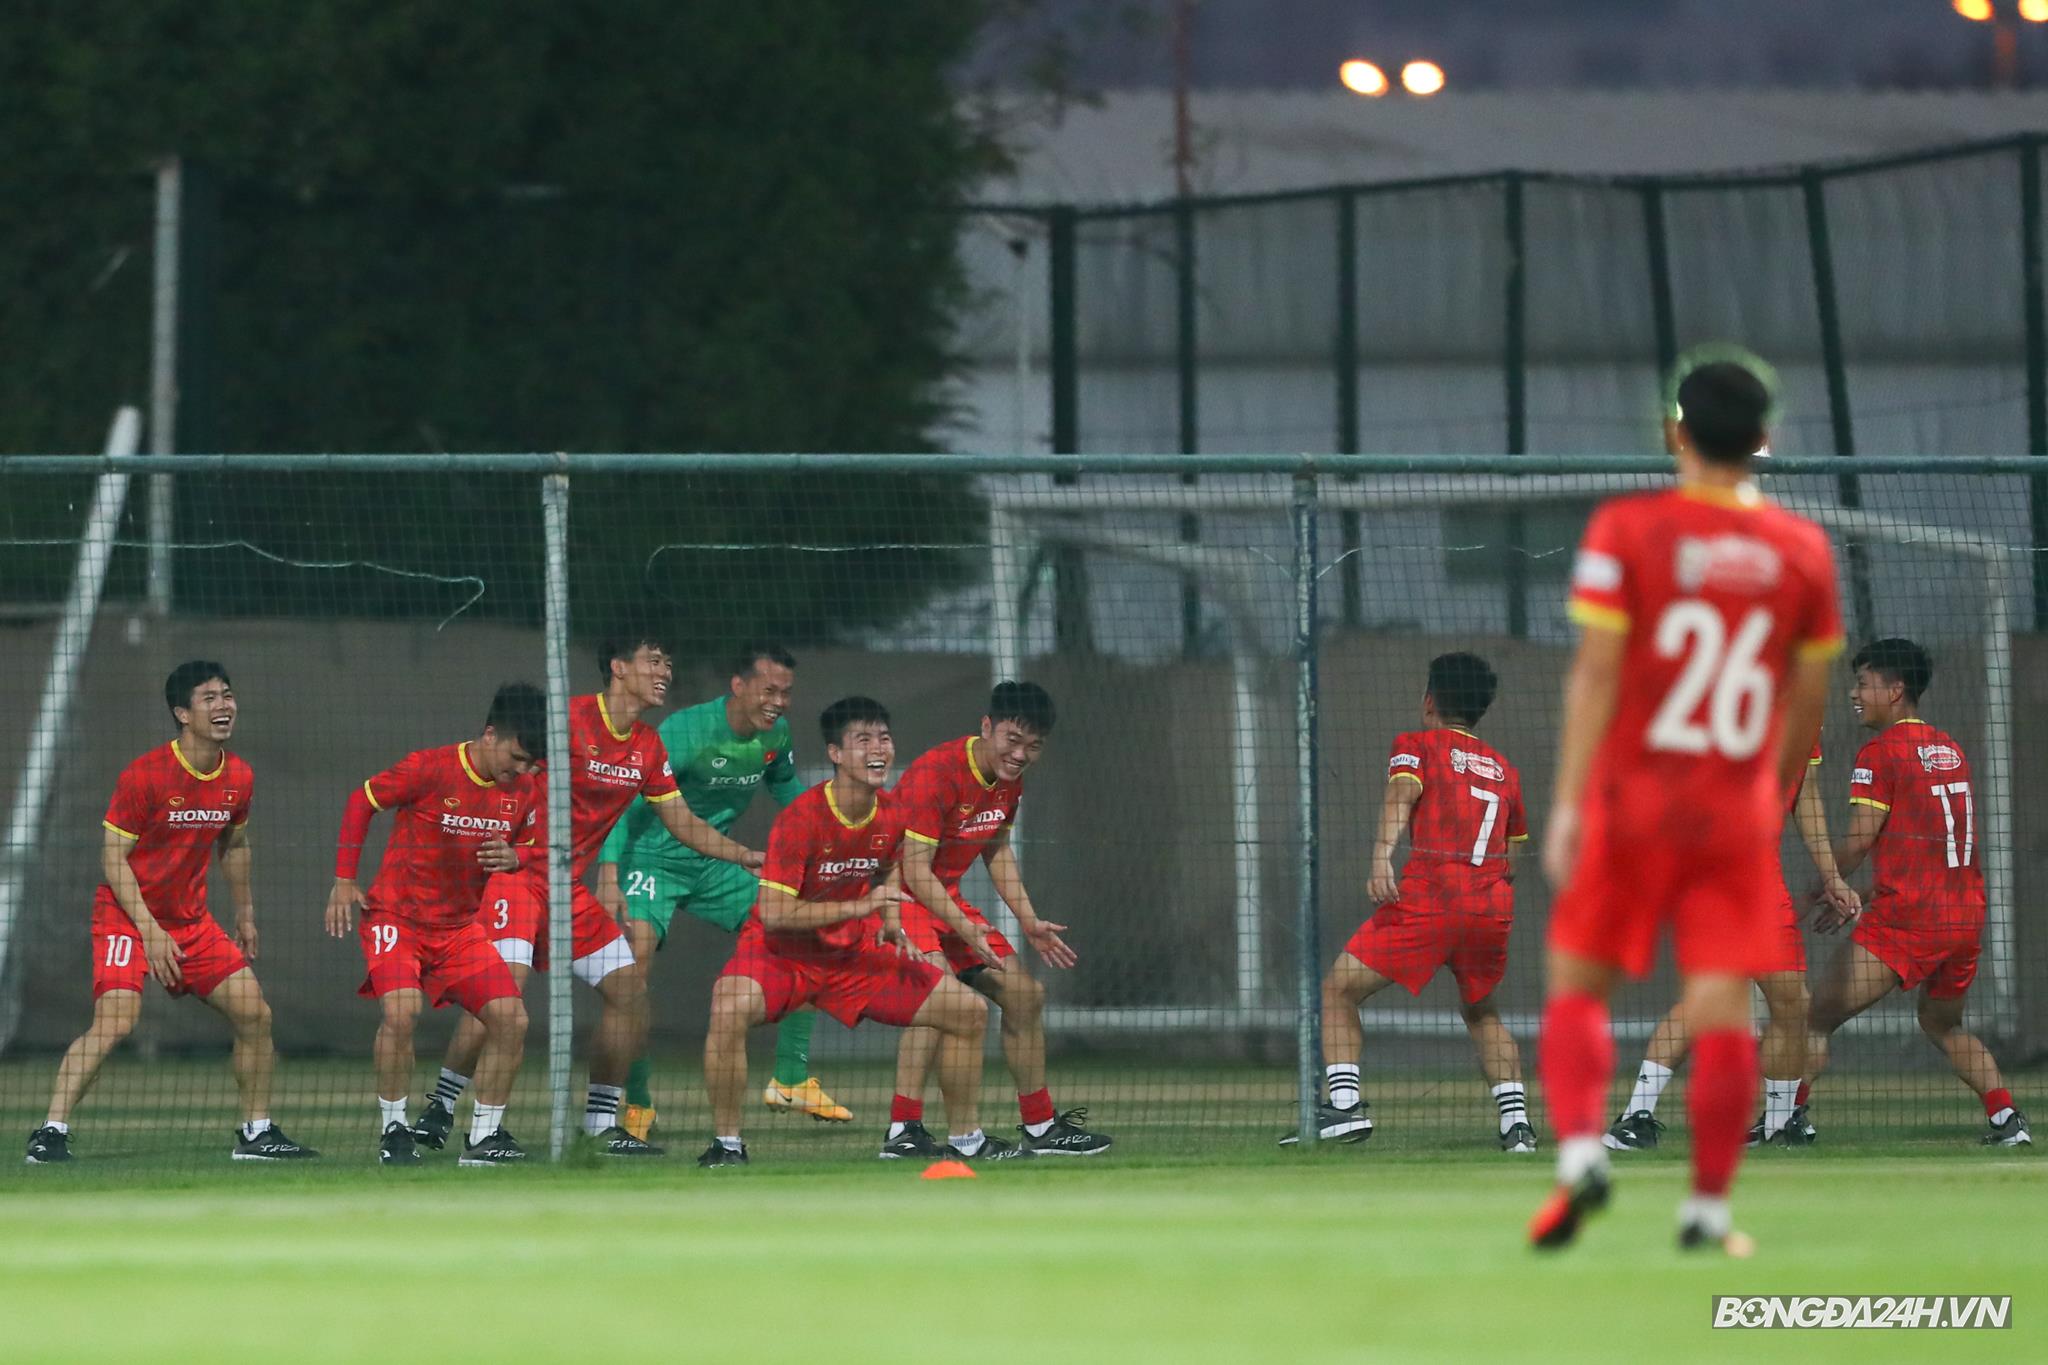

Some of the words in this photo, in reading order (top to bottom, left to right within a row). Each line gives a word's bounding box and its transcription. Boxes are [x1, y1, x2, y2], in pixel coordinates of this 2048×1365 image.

[1646, 599, 1775, 762] 26
[588, 760, 642, 780] HONDA
[168, 809, 231, 822] HONDA
[441, 814, 511, 831] HONDA
[442, 826, 456, 835] The
[1470, 785, 1500, 867] 7
[1930, 781, 1974, 869] 17
[818, 858, 880, 874] HONDA
[625, 870, 656, 901] 24
[493, 899, 508, 930] 3
[106, 935, 132, 967] 10
[371, 924, 398, 956] 19
